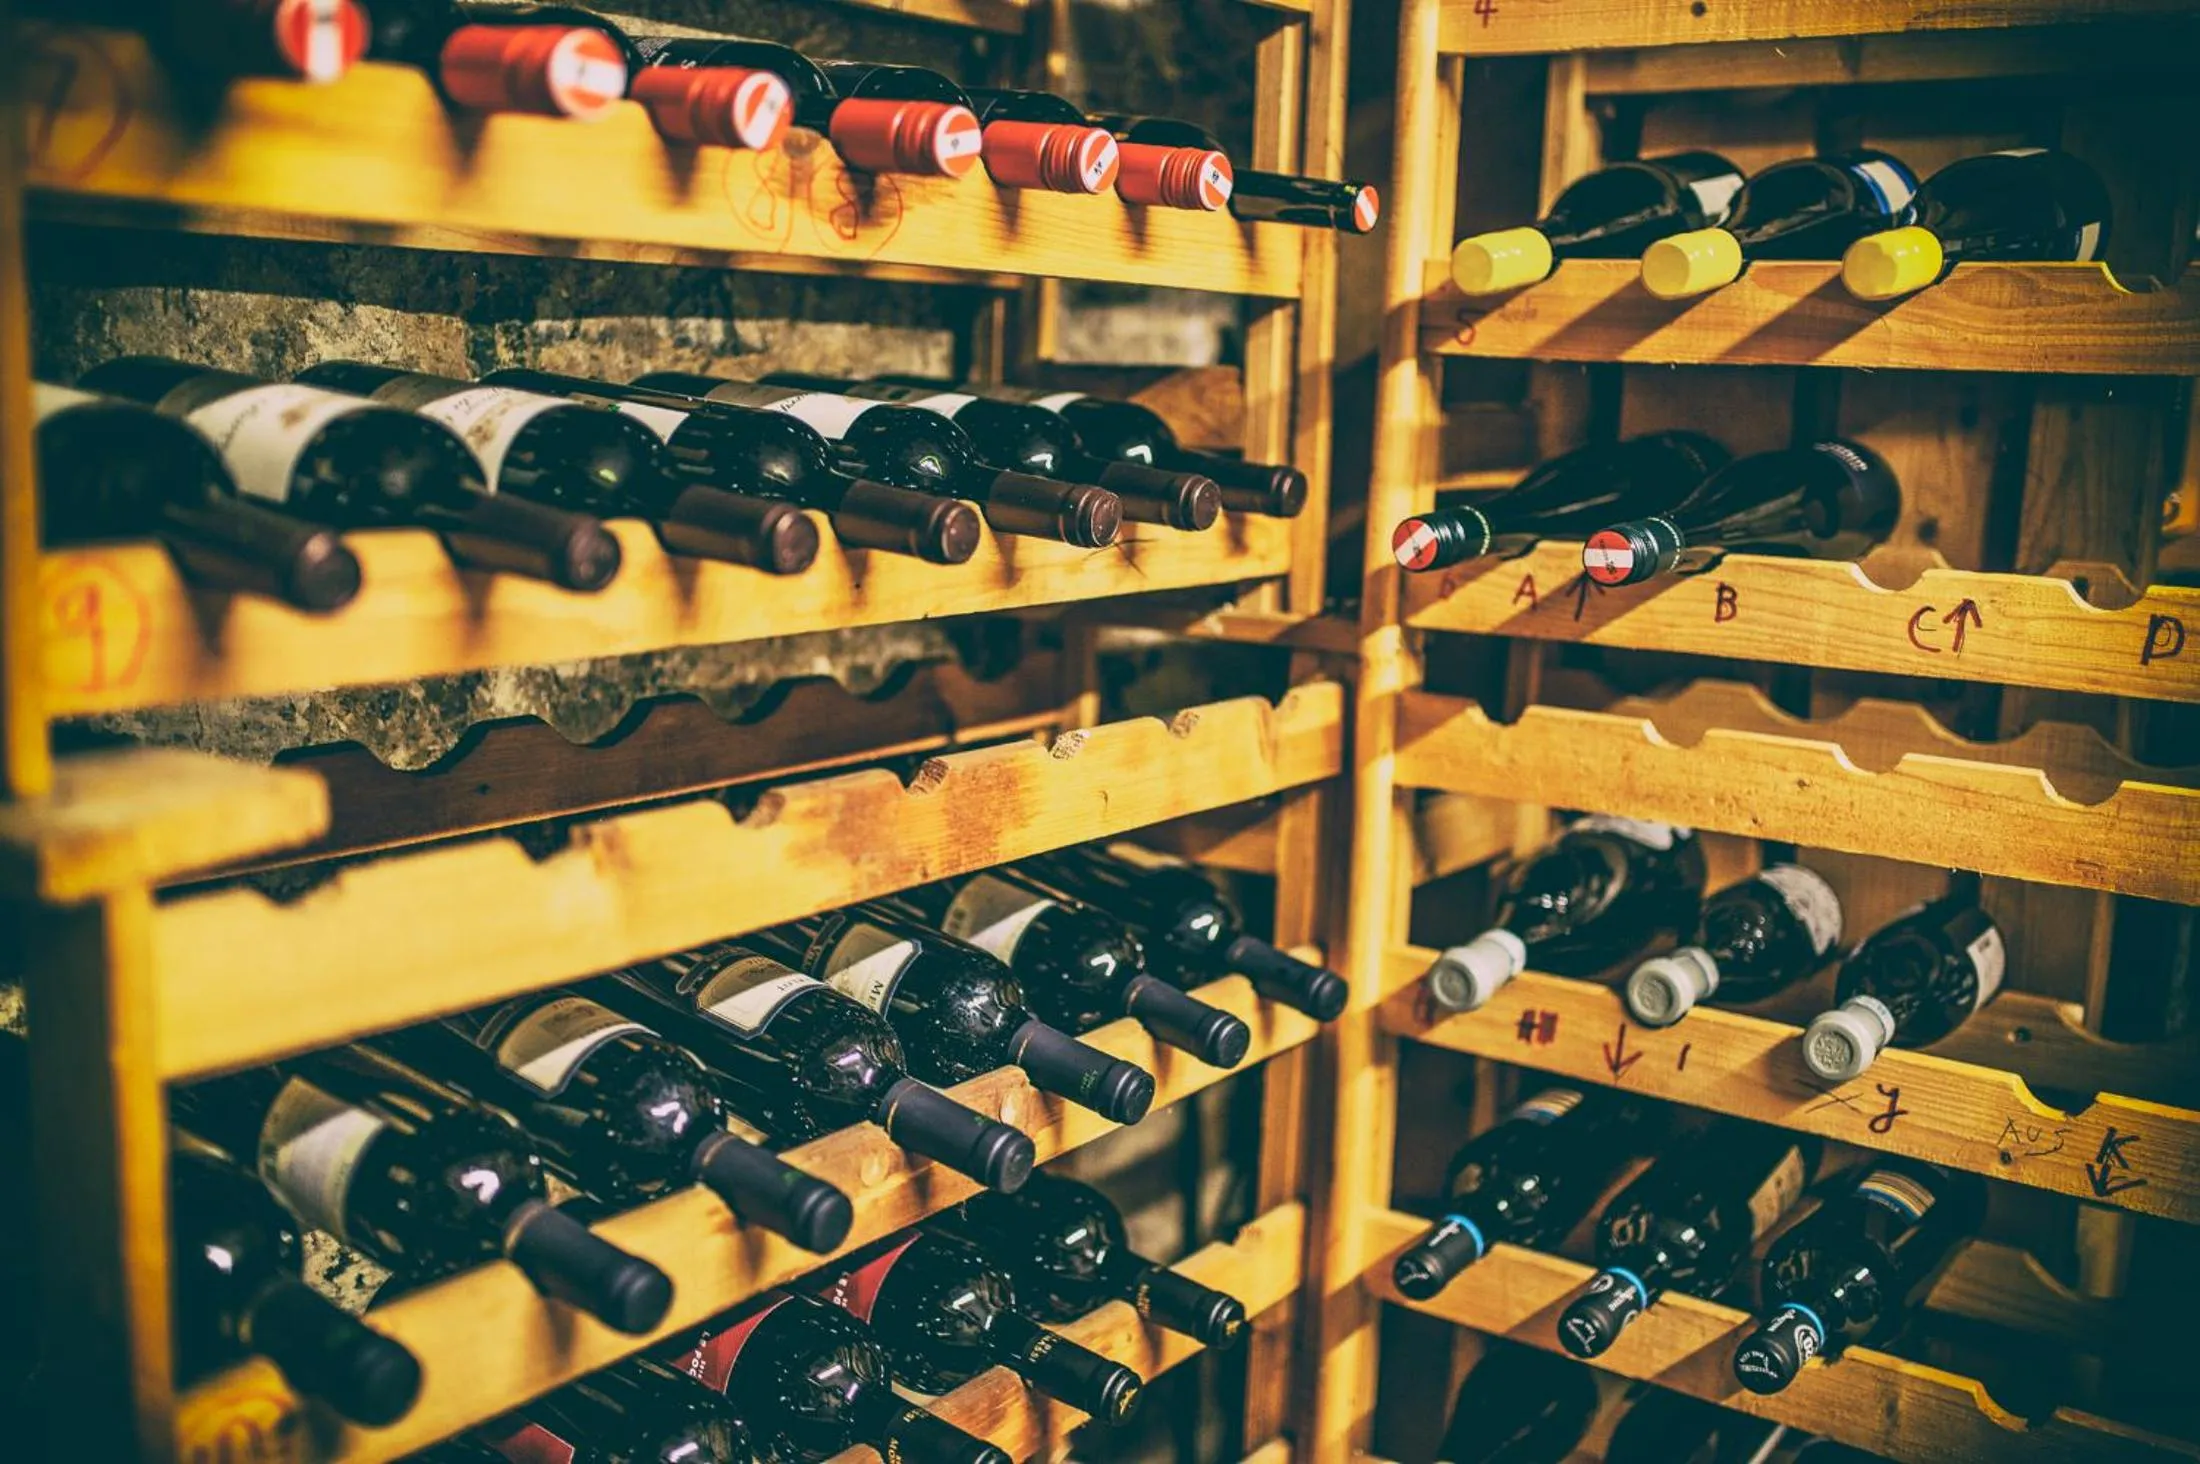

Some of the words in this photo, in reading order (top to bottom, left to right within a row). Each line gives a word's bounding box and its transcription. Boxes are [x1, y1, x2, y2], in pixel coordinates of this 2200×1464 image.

[1512, 573, 1538, 612] A
[1714, 581, 1737, 623] B
[1907, 605, 1942, 653] C
